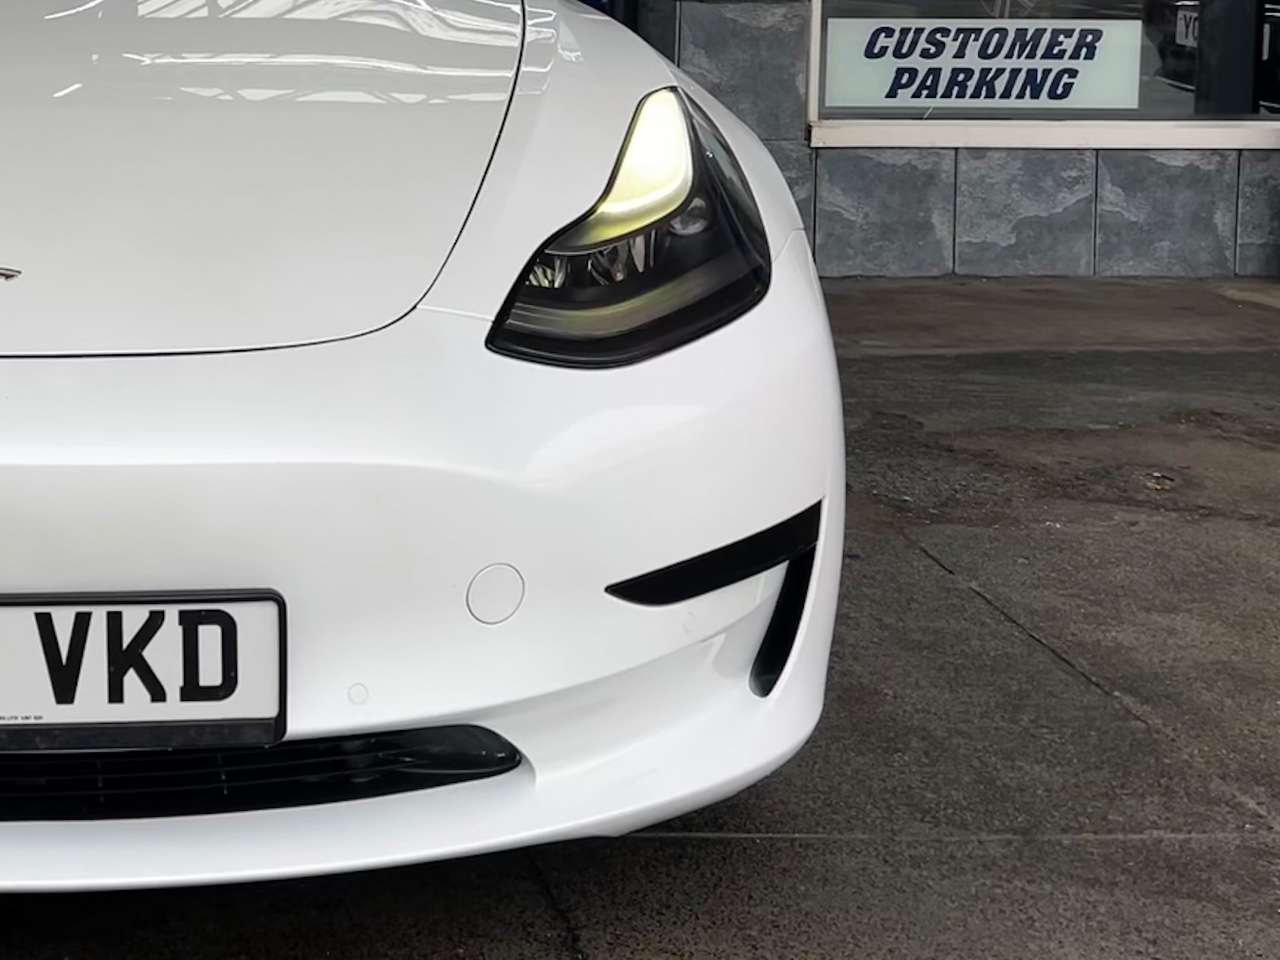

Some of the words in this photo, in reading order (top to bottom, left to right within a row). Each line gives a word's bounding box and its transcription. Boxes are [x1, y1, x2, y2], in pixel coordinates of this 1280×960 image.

[864, 26, 1103, 60] CUSTOMER
[885, 67, 1079, 101] PARKING
[35, 610, 238, 704] VKD
